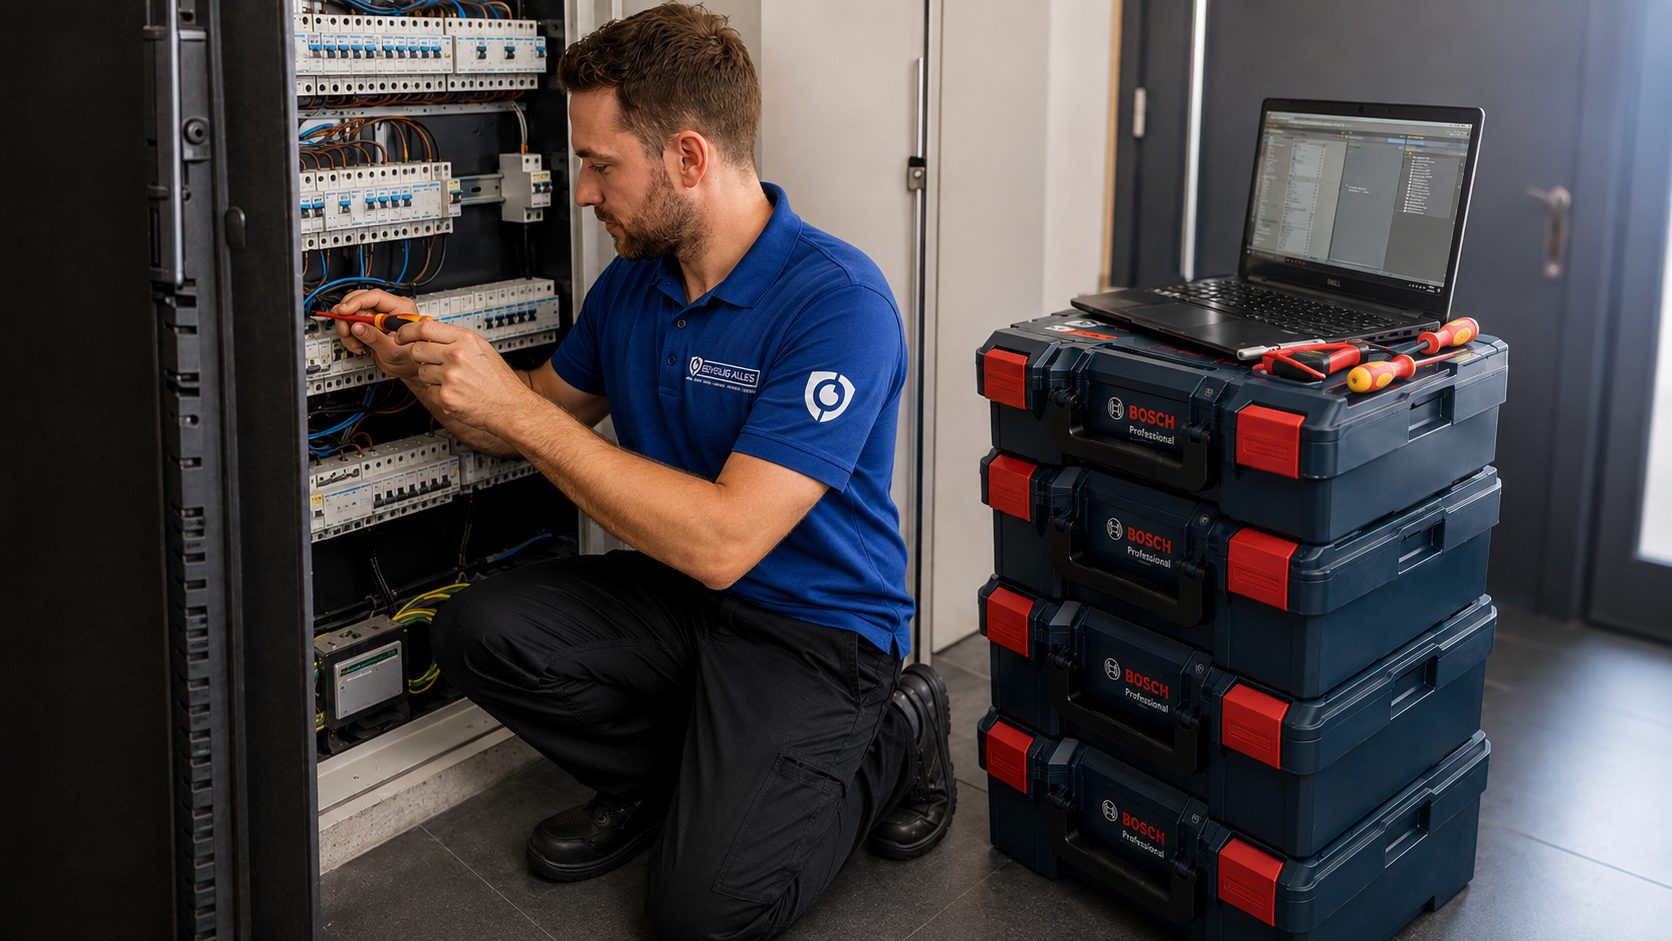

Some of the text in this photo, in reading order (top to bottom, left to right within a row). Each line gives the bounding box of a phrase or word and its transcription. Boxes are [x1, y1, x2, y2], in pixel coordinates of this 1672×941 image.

[731, 370, 756, 383] ALLES
[1128, 404, 1175, 430] BOSCH
[1129, 425, 1175, 445] Professional
[1127, 527, 1172, 555] BOSCH
[1125, 668, 1169, 699] BOSCH
[1122, 811, 1165, 846] BOSCH
